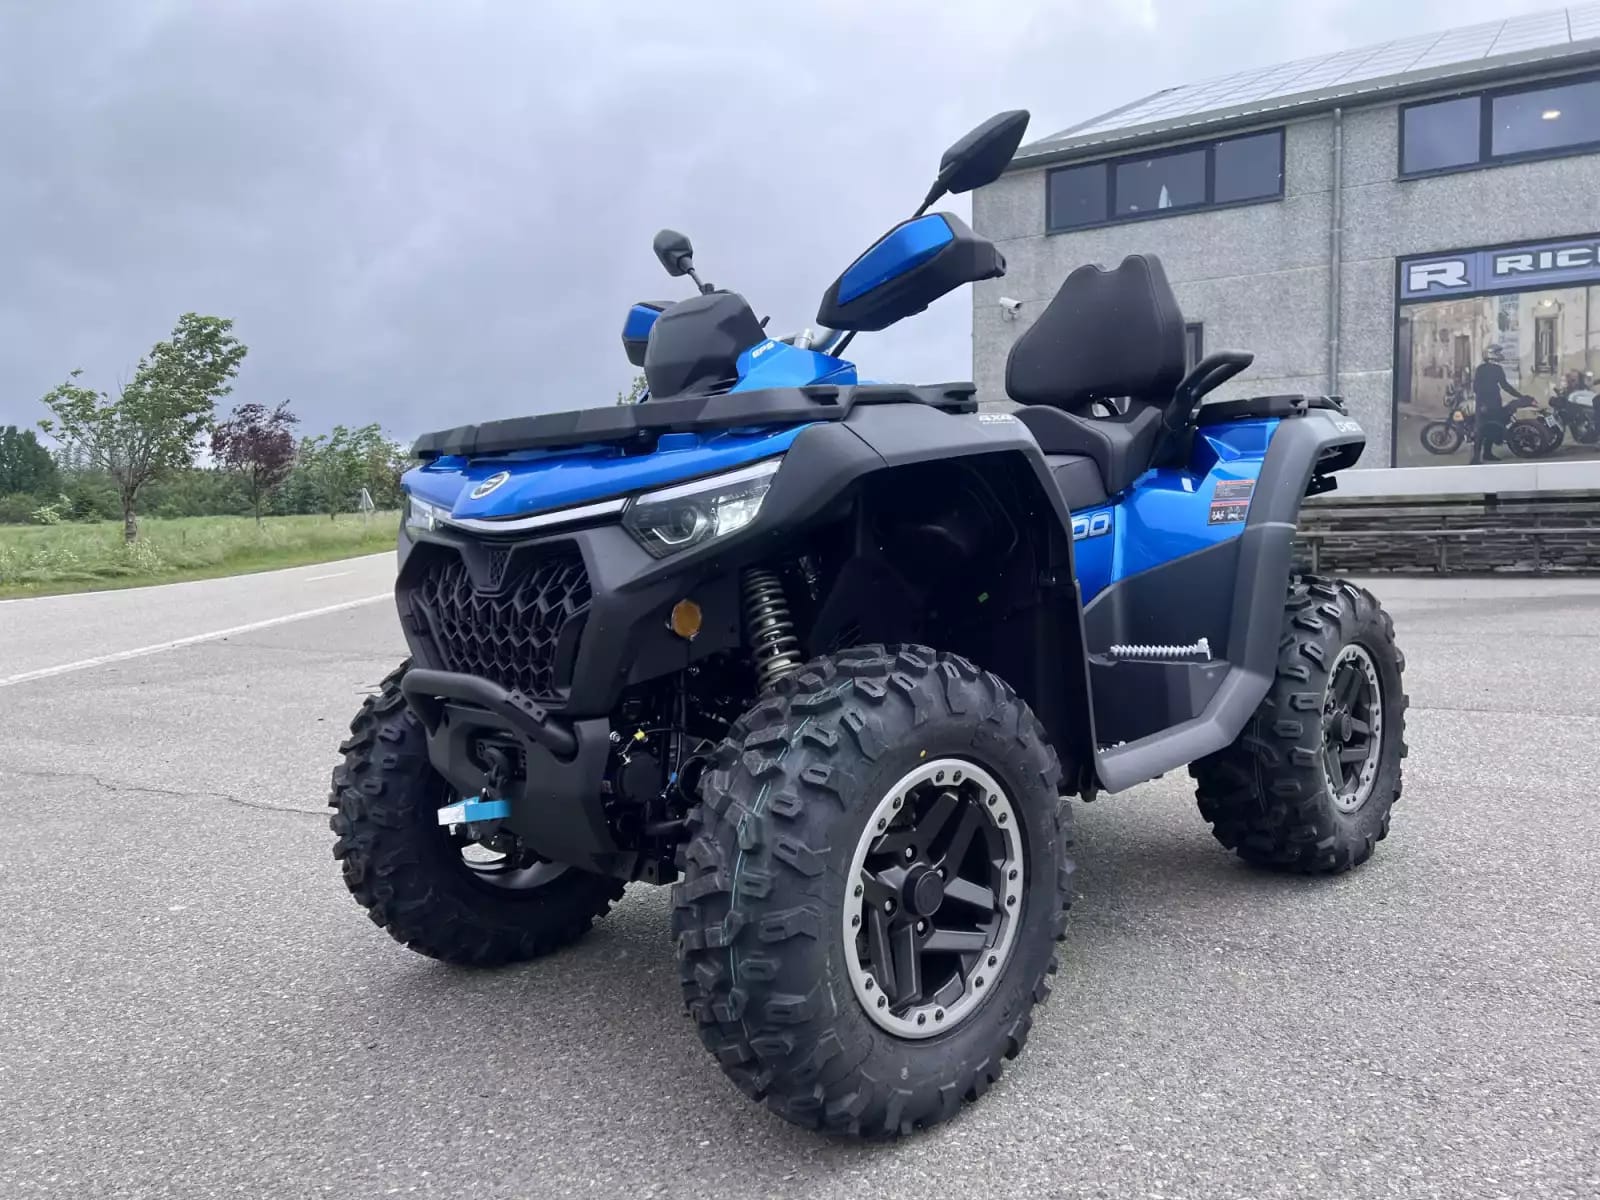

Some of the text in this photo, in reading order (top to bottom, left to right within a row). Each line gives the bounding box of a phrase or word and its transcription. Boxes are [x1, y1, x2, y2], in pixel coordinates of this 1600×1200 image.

[1410, 246, 1600, 291] R RIC
[752, 341, 775, 359] EPS
